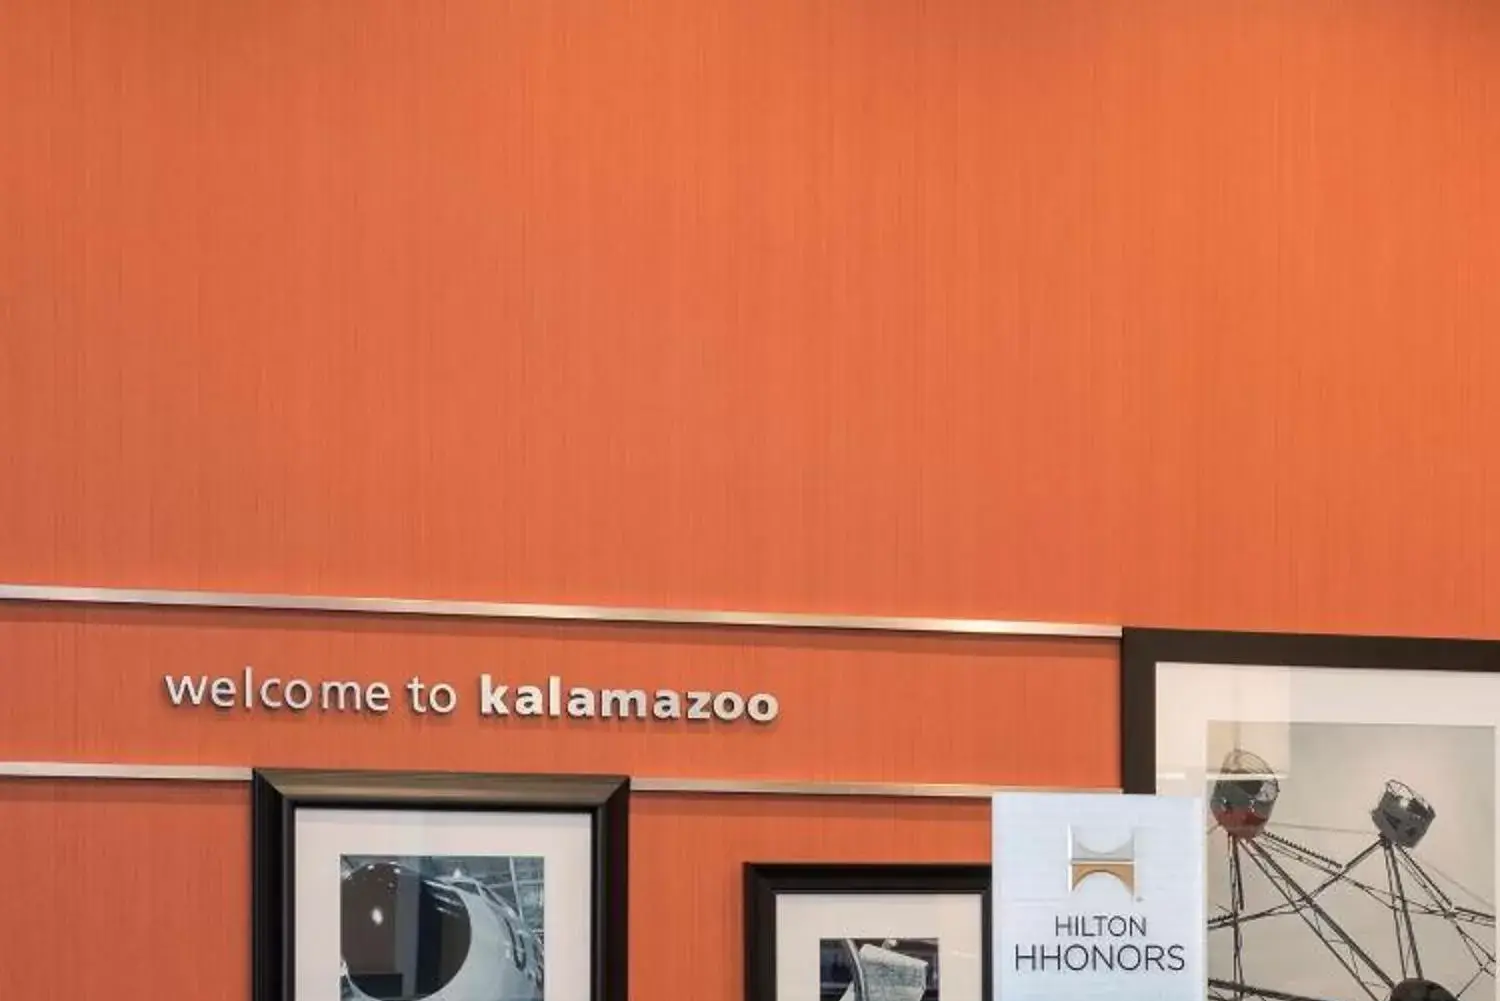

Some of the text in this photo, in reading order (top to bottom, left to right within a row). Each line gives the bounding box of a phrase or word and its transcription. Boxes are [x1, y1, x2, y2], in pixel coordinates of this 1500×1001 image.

[165, 666, 780, 722] welcome to kalamazoo
[1055, 915, 1147, 937] HILTON
[1015, 944, 1186, 971] HHONORS
